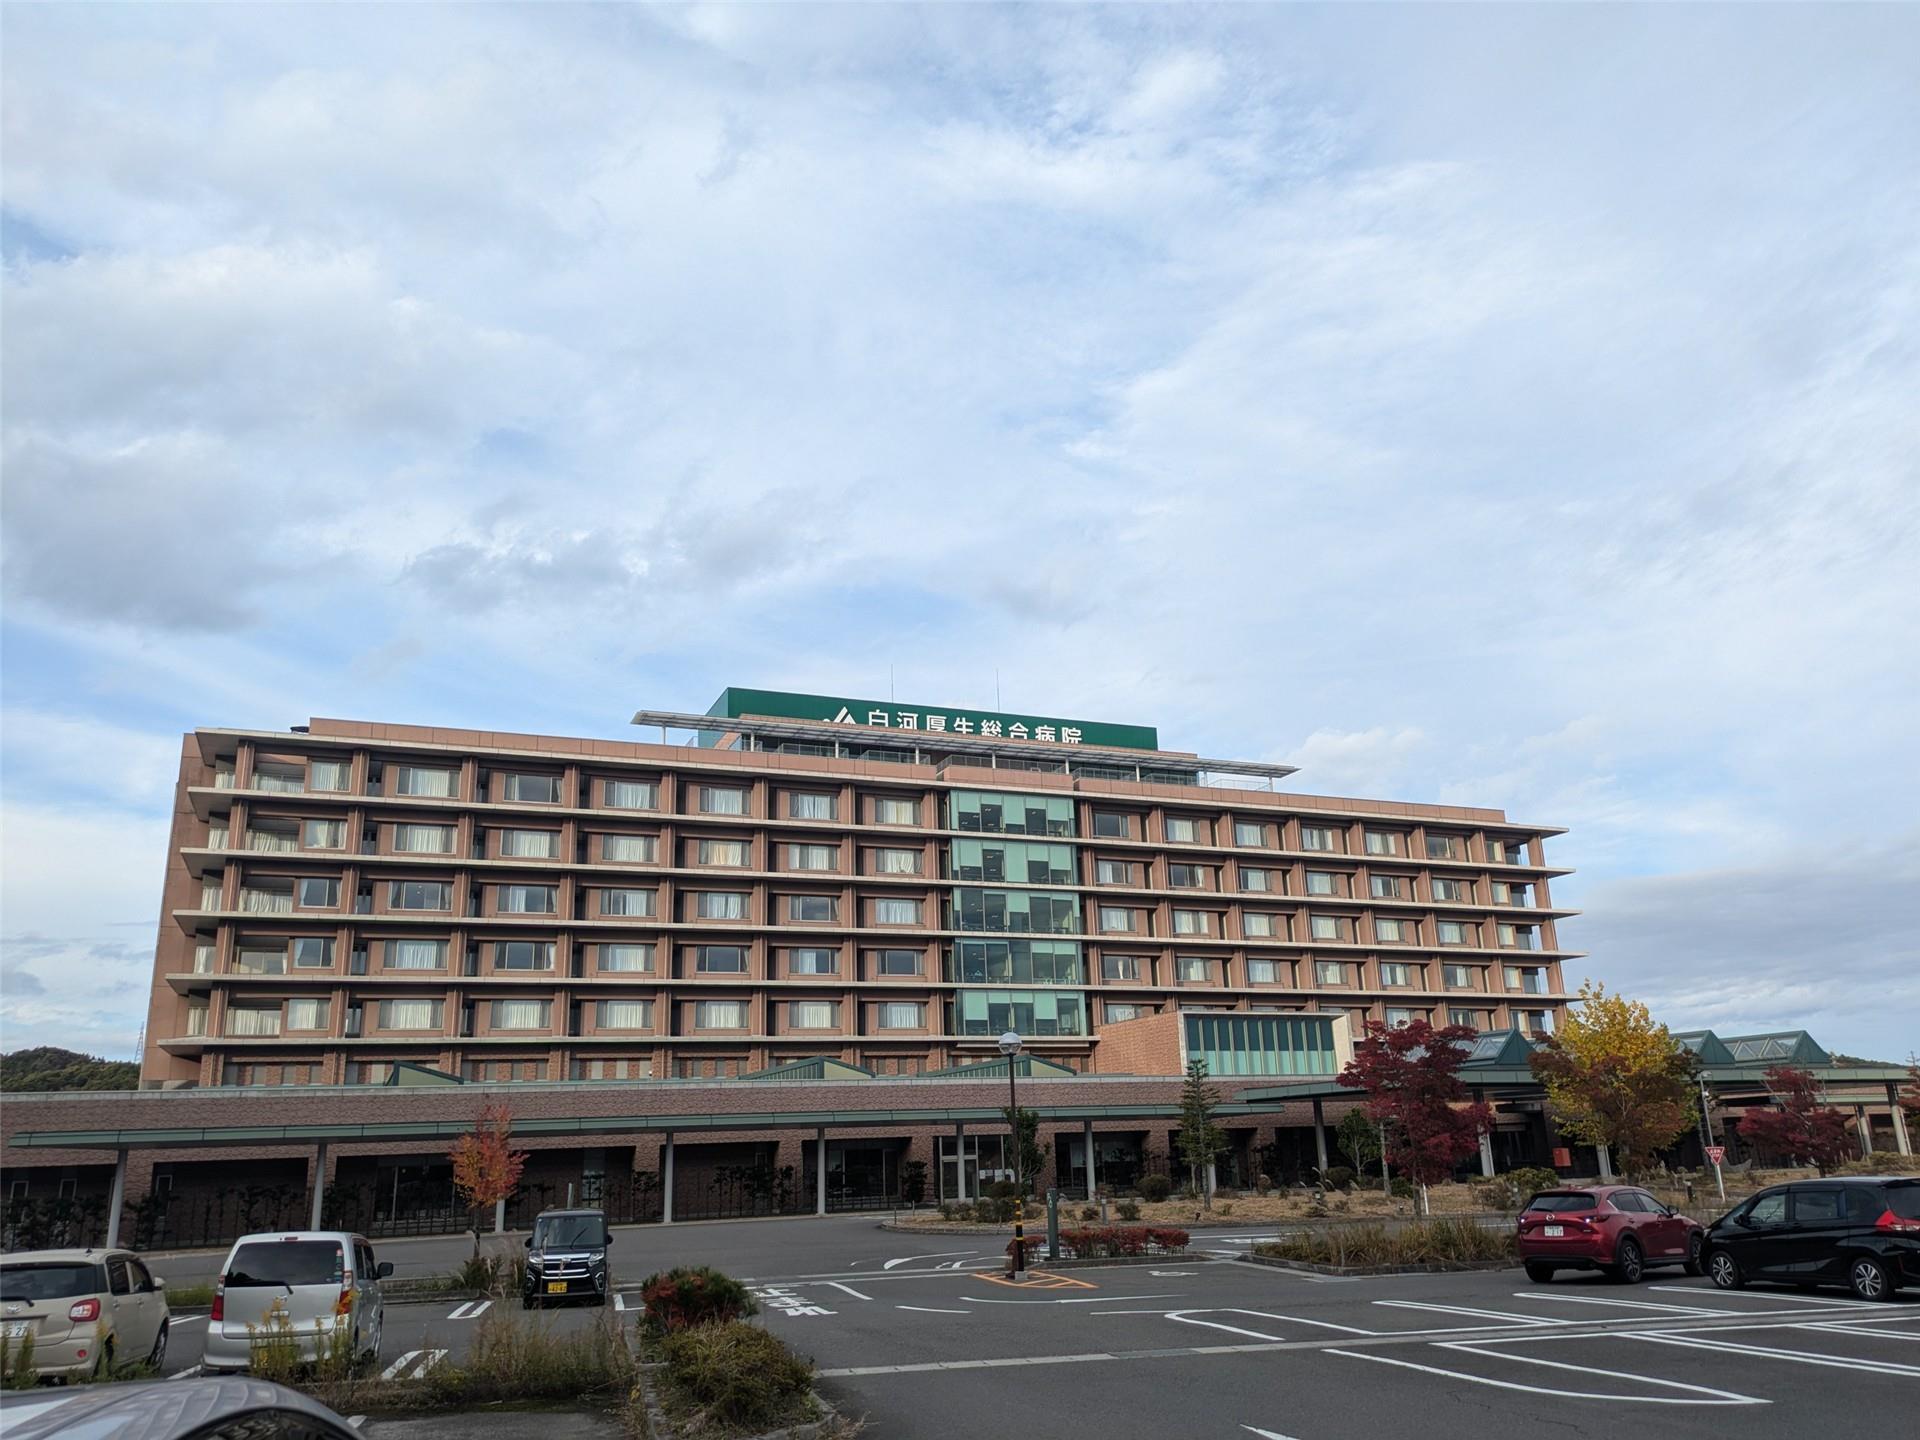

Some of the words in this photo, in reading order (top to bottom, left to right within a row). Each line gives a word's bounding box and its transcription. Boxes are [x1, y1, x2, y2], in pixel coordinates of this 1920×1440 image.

[868, 709, 1083, 744] 白河厚生総合病院
